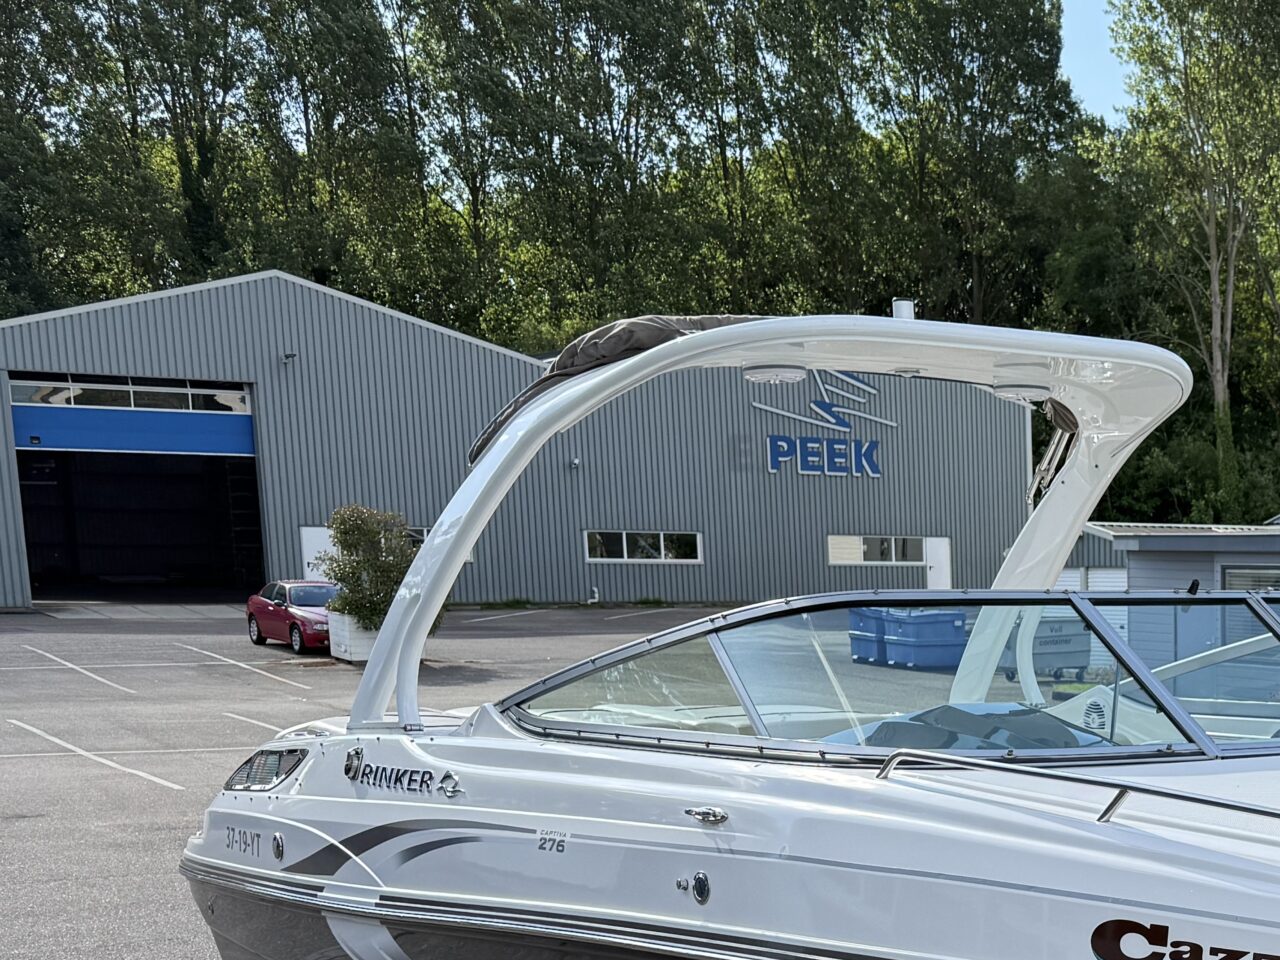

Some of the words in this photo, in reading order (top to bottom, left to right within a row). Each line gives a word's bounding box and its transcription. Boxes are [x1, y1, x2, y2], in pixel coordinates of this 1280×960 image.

[767, 434, 881, 478] PEEK
[1039, 638, 1072, 647] container
[360, 763, 435, 794] RINKER
[540, 829, 567, 838] CAPTIVA
[538, 836, 566, 853] 276
